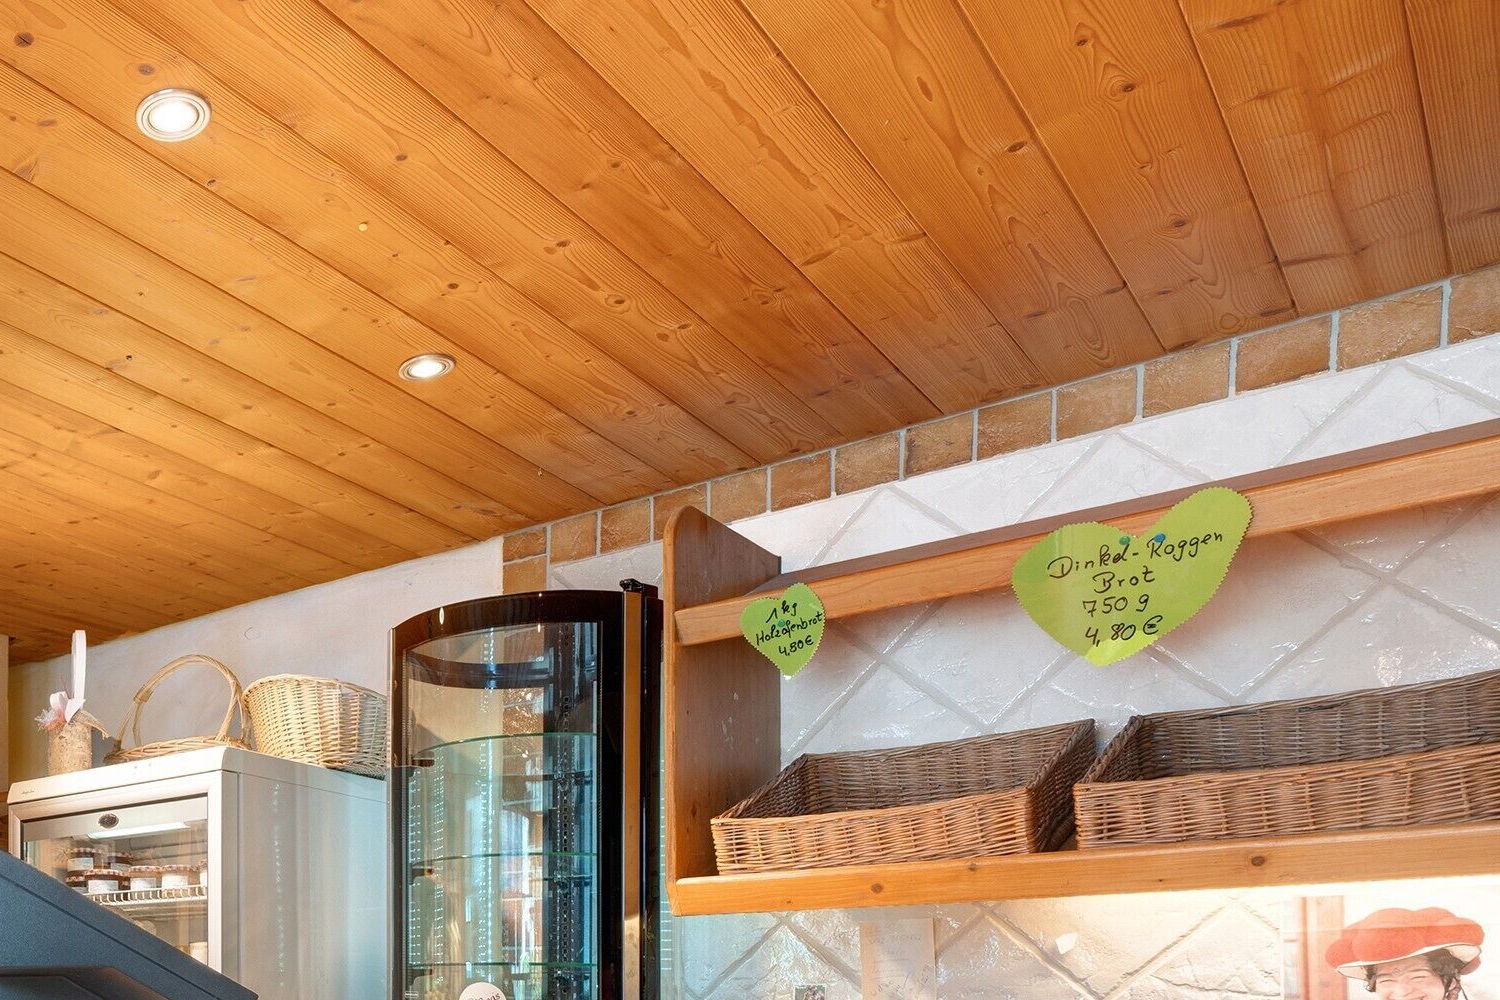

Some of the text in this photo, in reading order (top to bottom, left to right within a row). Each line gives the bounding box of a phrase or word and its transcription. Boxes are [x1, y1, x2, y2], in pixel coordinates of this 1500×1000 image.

[1146, 532, 1223, 562] Roggen
[1092, 565, 1156, 594] Brot
[756, 611, 823, 646] Holzofenbrot
